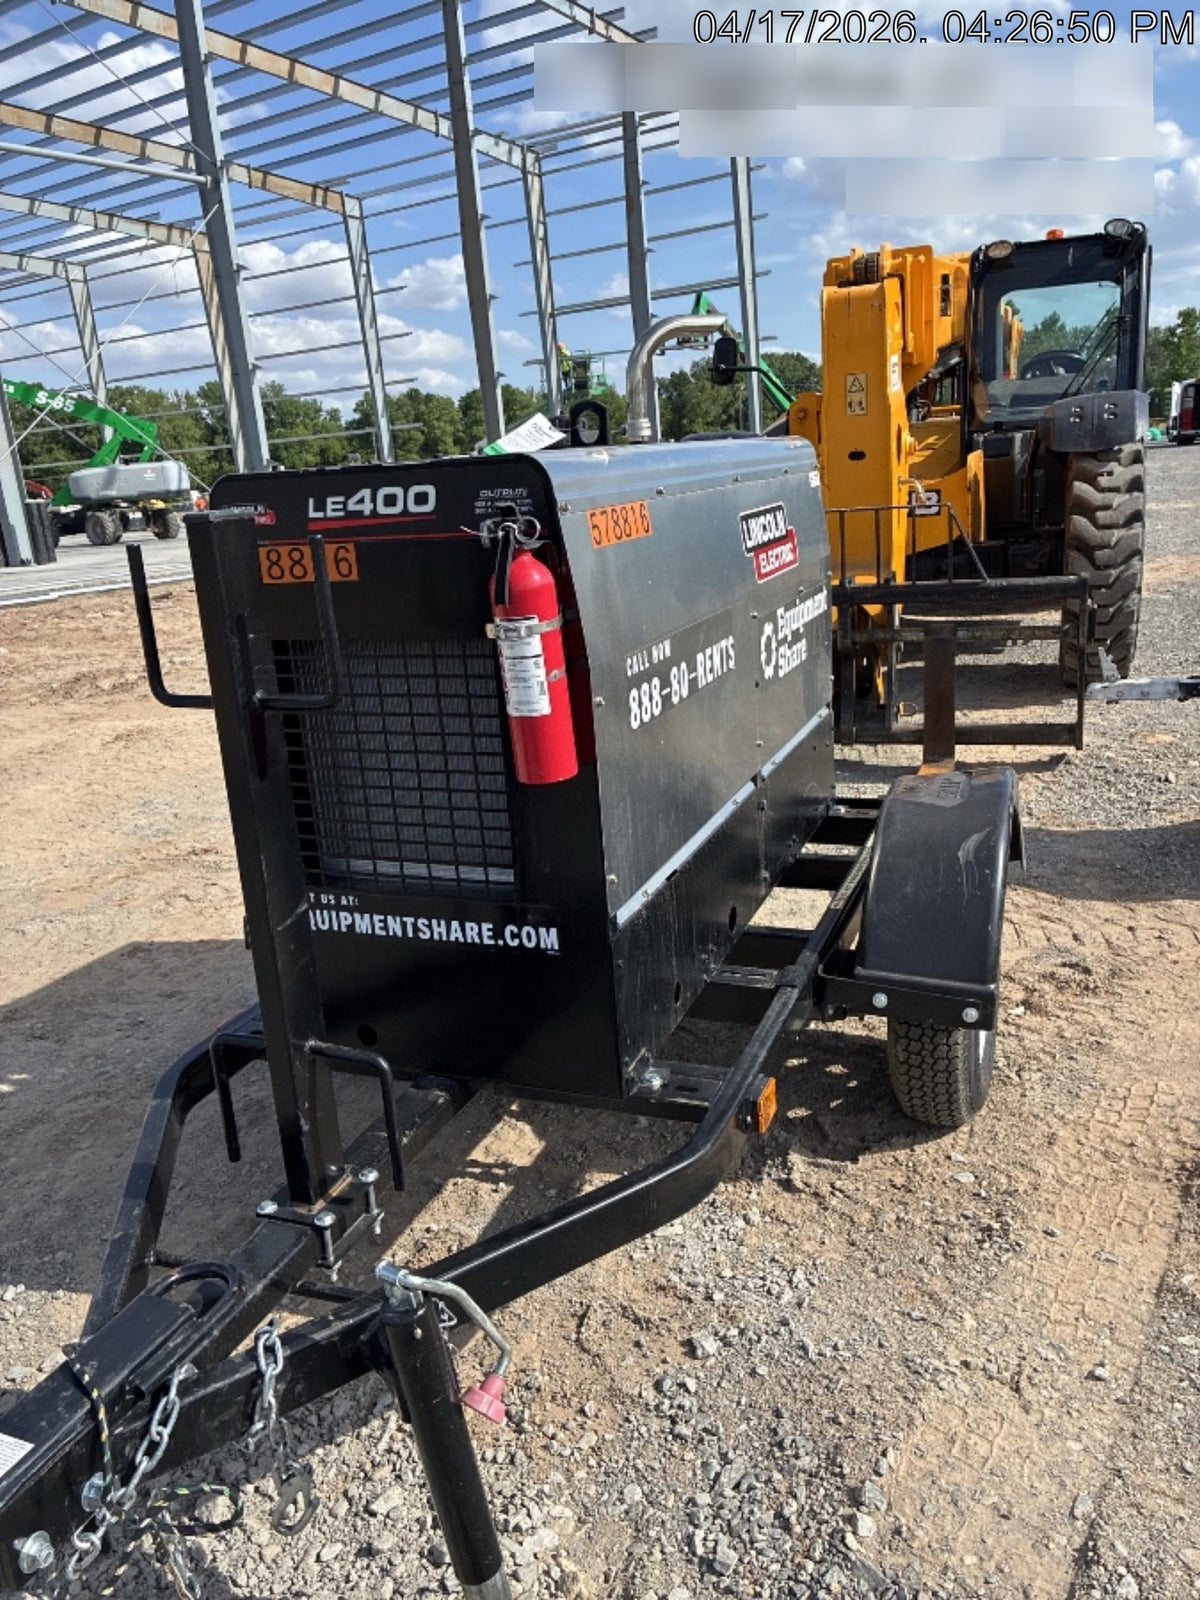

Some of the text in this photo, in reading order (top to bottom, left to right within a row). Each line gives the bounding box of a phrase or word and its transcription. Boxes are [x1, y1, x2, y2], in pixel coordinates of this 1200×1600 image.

[307, 484, 436, 519] LE400
[589, 503, 650, 546] 578816
[742, 510, 787, 549] LINCOLN
[266, 545, 353, 580] 886
[759, 542, 795, 574] ELECTRIC
[776, 585, 828, 642] Equipment
[626, 650, 650, 677] CALL
[778, 637, 807, 678] Share
[629, 635, 736, 730] 888-80-RENTS
[320, 893, 335, 905] US
[308, 909, 559, 951] UIPMENTSHARE.COM
